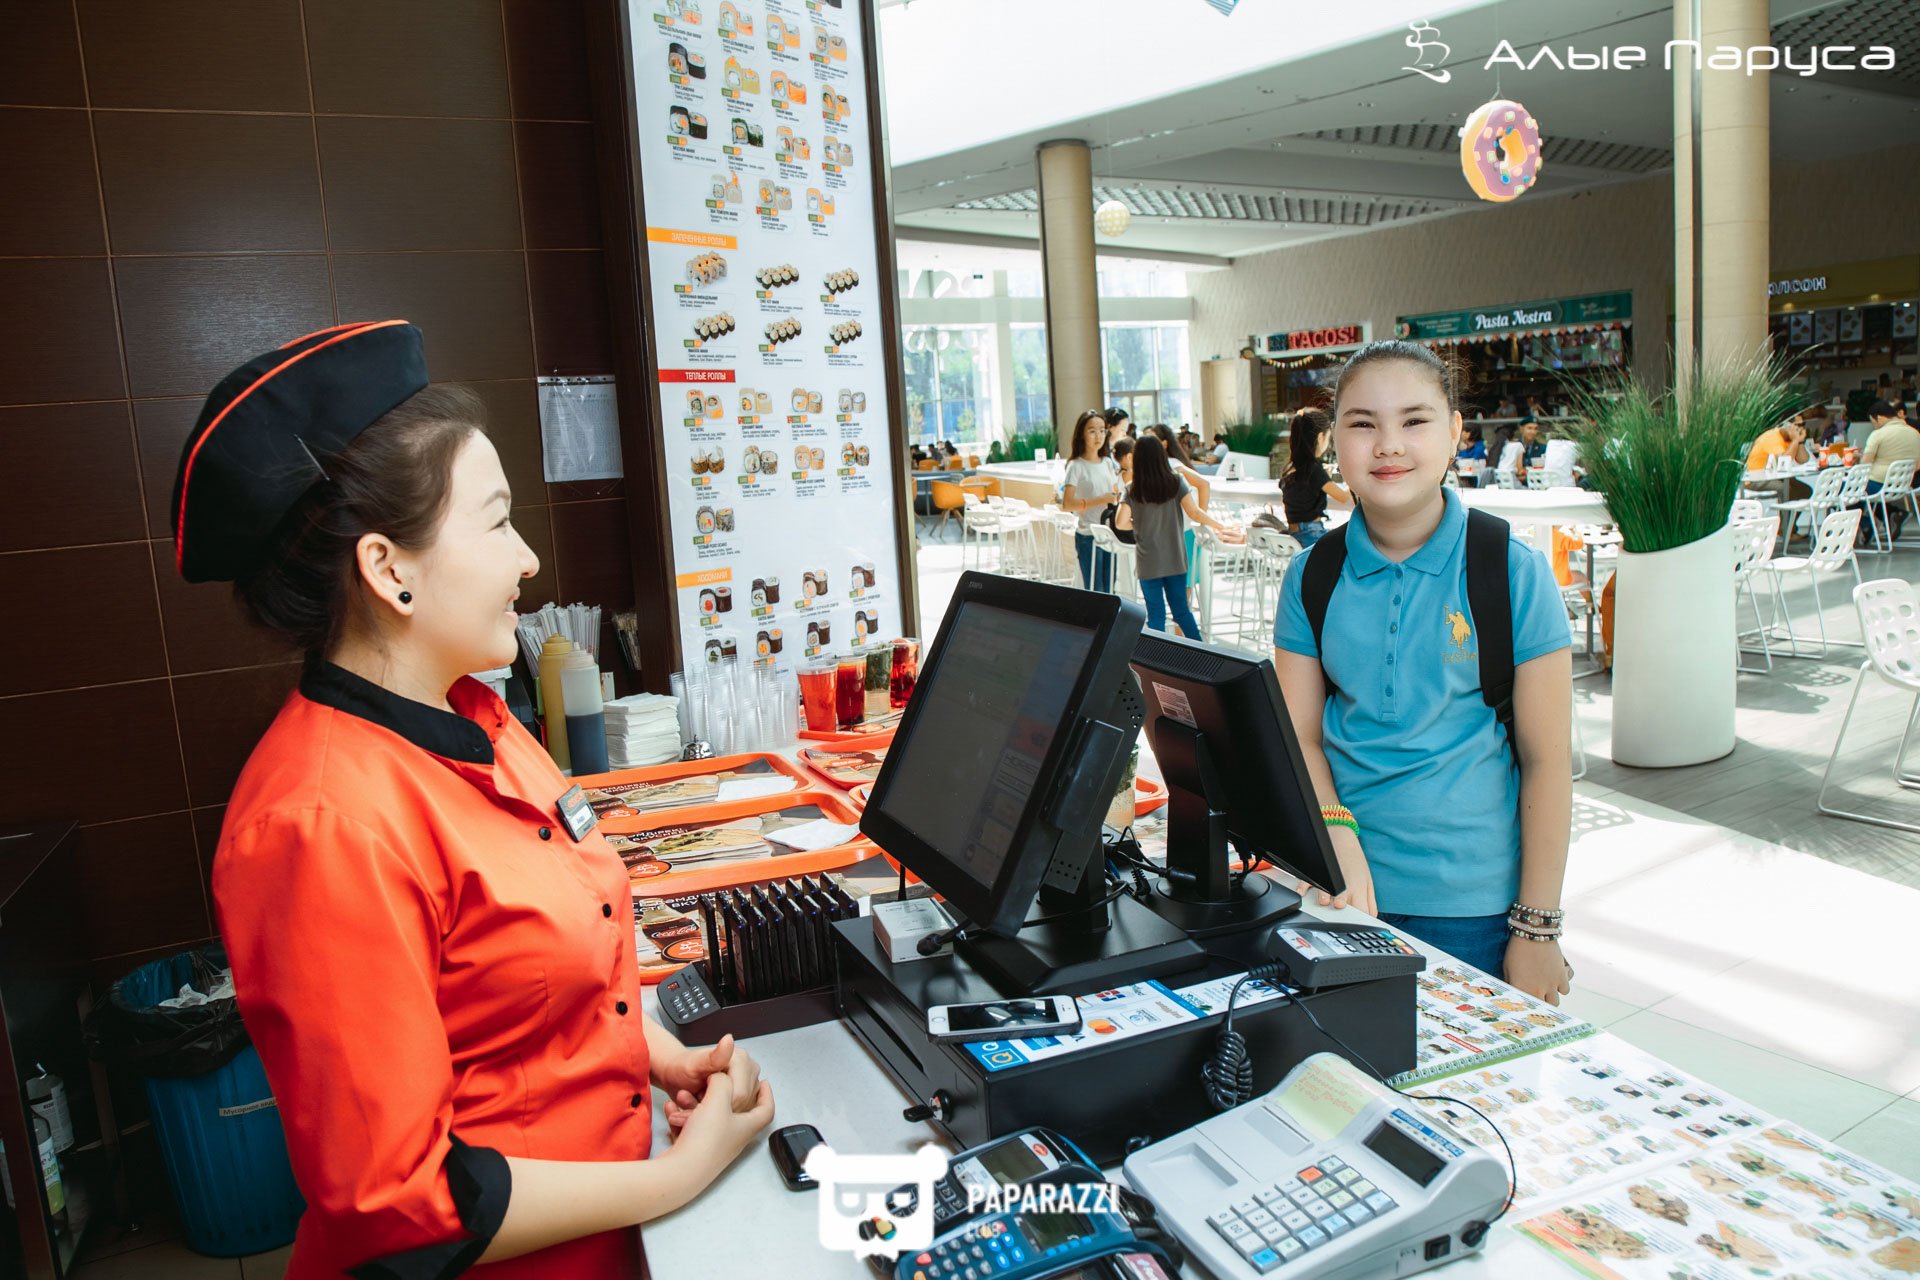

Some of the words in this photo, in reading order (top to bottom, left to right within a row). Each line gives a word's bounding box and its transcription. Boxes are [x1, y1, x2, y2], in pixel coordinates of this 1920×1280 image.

[1475, 313, 1509, 330] Pasta
[1512, 308, 1553, 325] Nostra
[1288, 325, 1355, 350] TACOS!
[685, 371, 707, 380] ТЕПЛЫЕ
[707, 371, 726, 380] РОЛЛЫ
